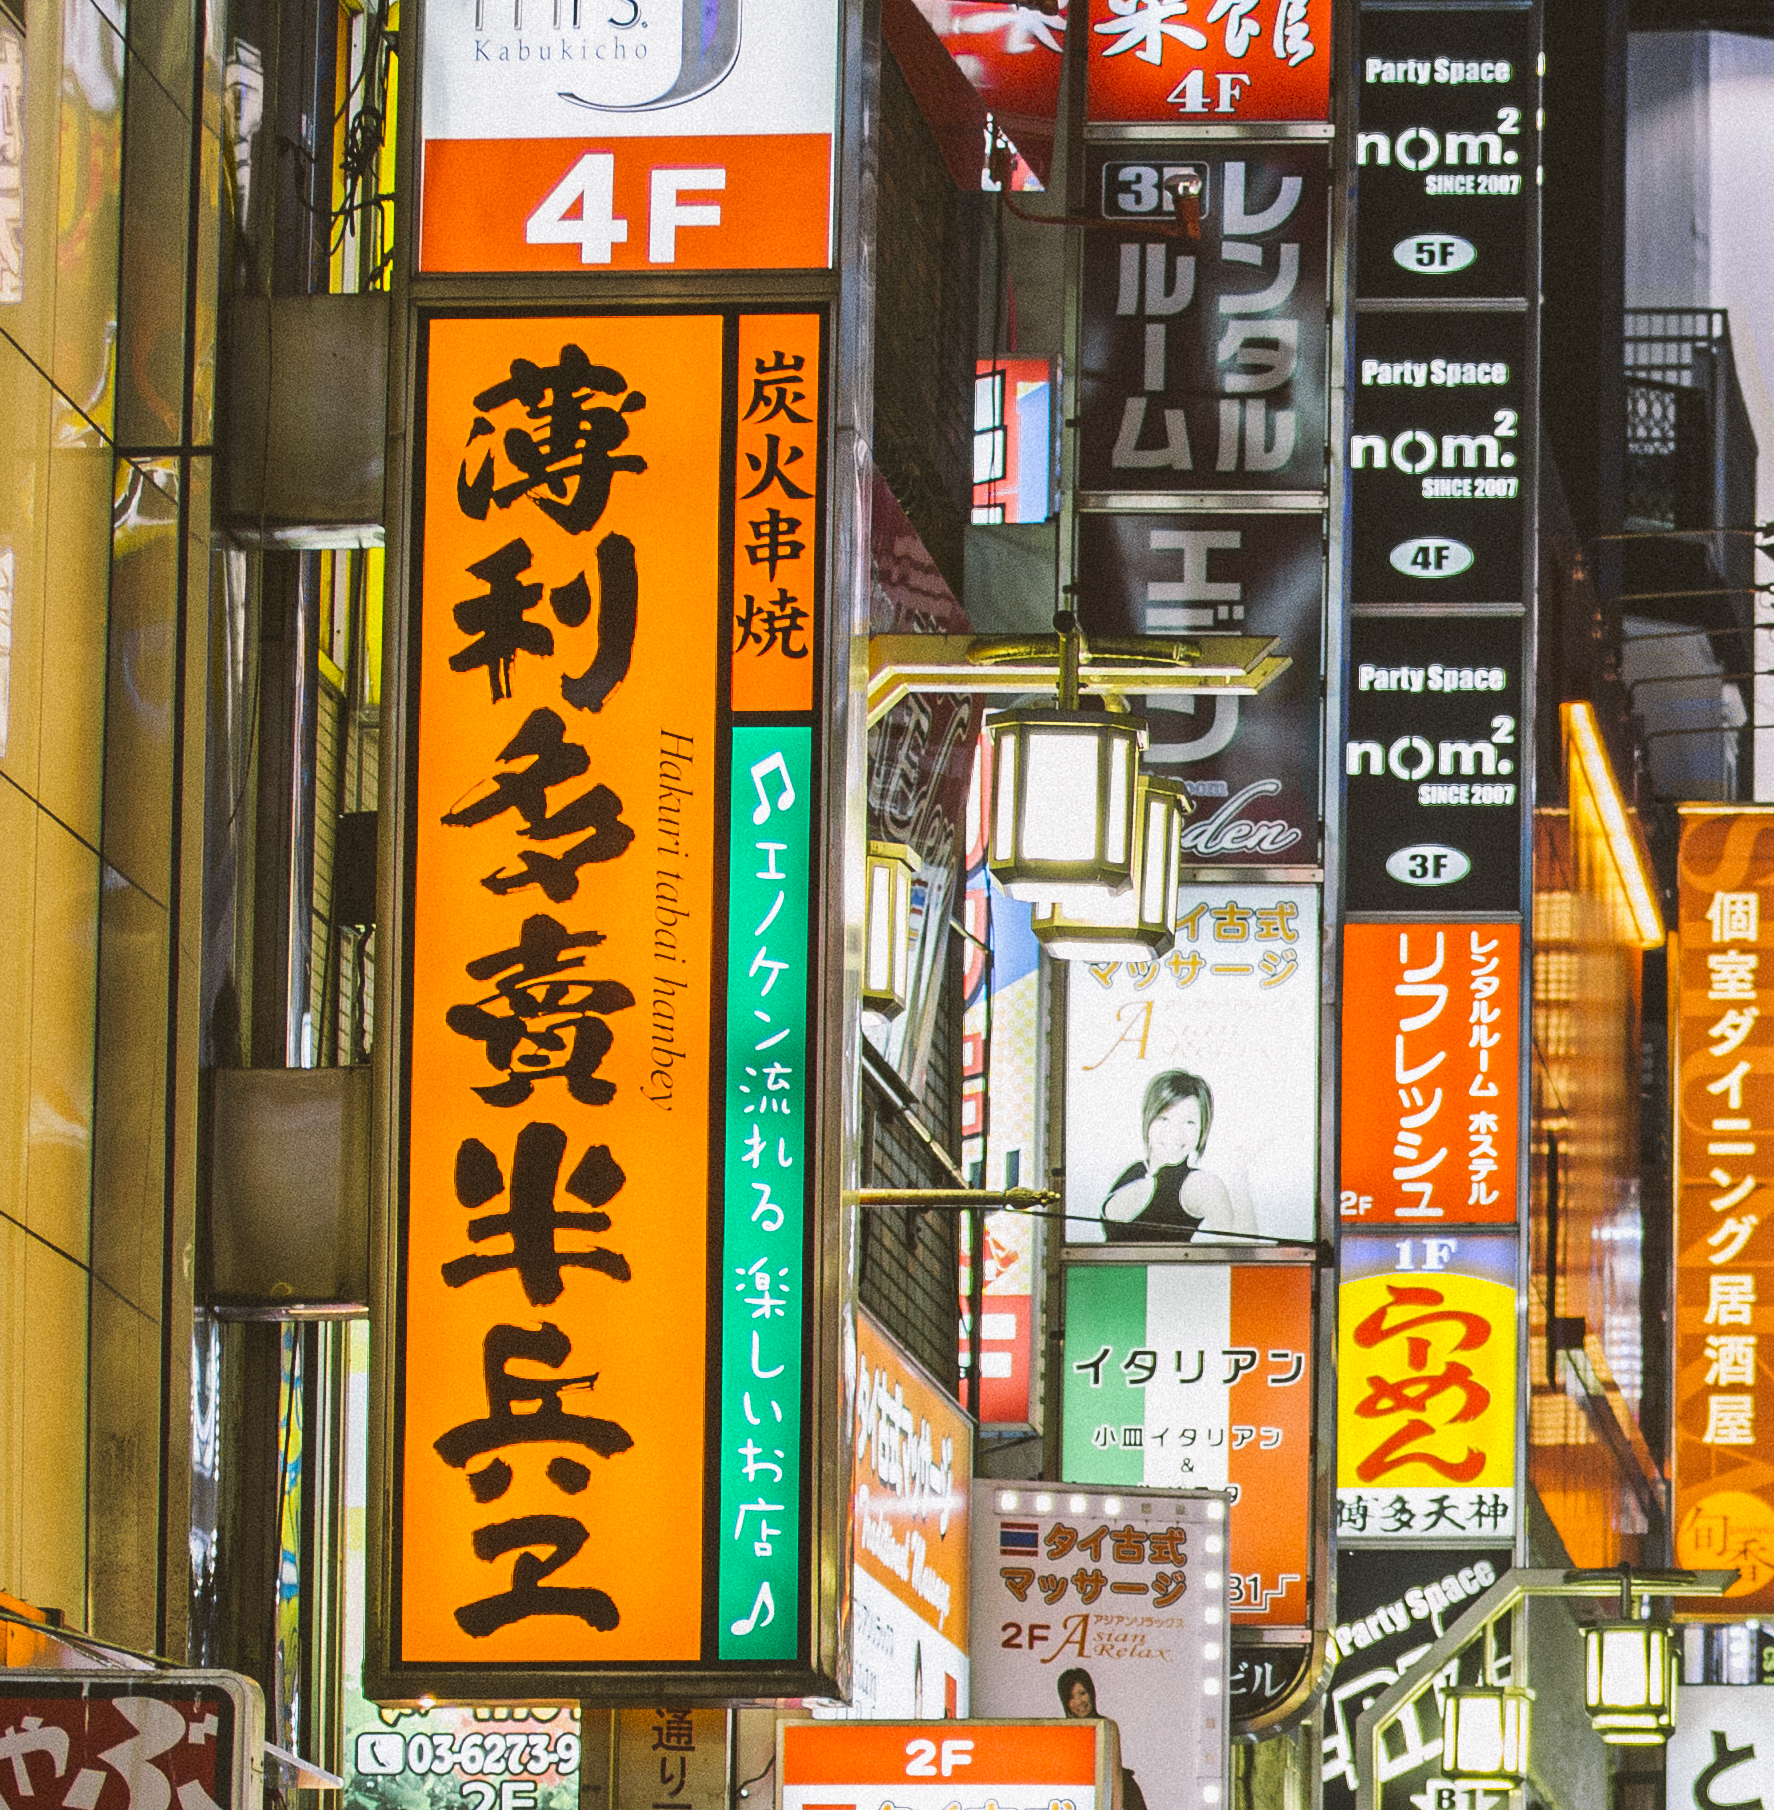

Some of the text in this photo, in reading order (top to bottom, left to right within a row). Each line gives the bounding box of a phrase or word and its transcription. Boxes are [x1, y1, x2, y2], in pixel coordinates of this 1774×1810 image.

[475, 39, 647, 61] Kabukicho
[1366, 59, 1510, 85] Party Space
[1166, 71, 1251, 113] 4F
[1427, 175, 1520, 194] SINCE 2007
[526, 151, 726, 265] 4F
[1416, 243, 1455, 266] 5F
[1216, 161, 1303, 471] レンタル
[1111, 243, 1198, 472] ルーム
[1362, 361, 1508, 386] Party Space
[1422, 478, 1517, 497] SINCE 2007
[735, 350, 815, 660] 炭火串焼
[1410, 545, 1450, 569] 4F
[1359, 666, 1505, 692] Party Space
[1419, 785, 1514, 805] SINCE 2007
[1408, 853, 1448, 879] 3F
[641, 728, 696, 1113] Hakuri tabai hanbey
[1391, 930, 1449, 1218] リフレッシュ
[1468, 931, 1499, 1205] レンタルルーム ホステル
[1341, 1191, 1372, 1215] 2F
[1396, 1239, 1457, 1271] 1F
[1073, 1348, 1304, 1387] イタリアン
[734, 1264, 792, 1558] 楽しいお店
[1094, 1425, 1282, 1448] 小皿イタリアン
[1181, 1458, 1194, 1473] &
[1336, 1493, 1509, 1532] 博多天神
[1044, 1524, 1188, 1567] タイ古式
[999, 1567, 1187, 1609] マッサージ
[1337, 1557, 1496, 1657] Party Space
[1002, 1625, 1050, 1650] 2F
[905, 1738, 975, 1777] 2F
[1435, 1789, 1477, 1810] B1
